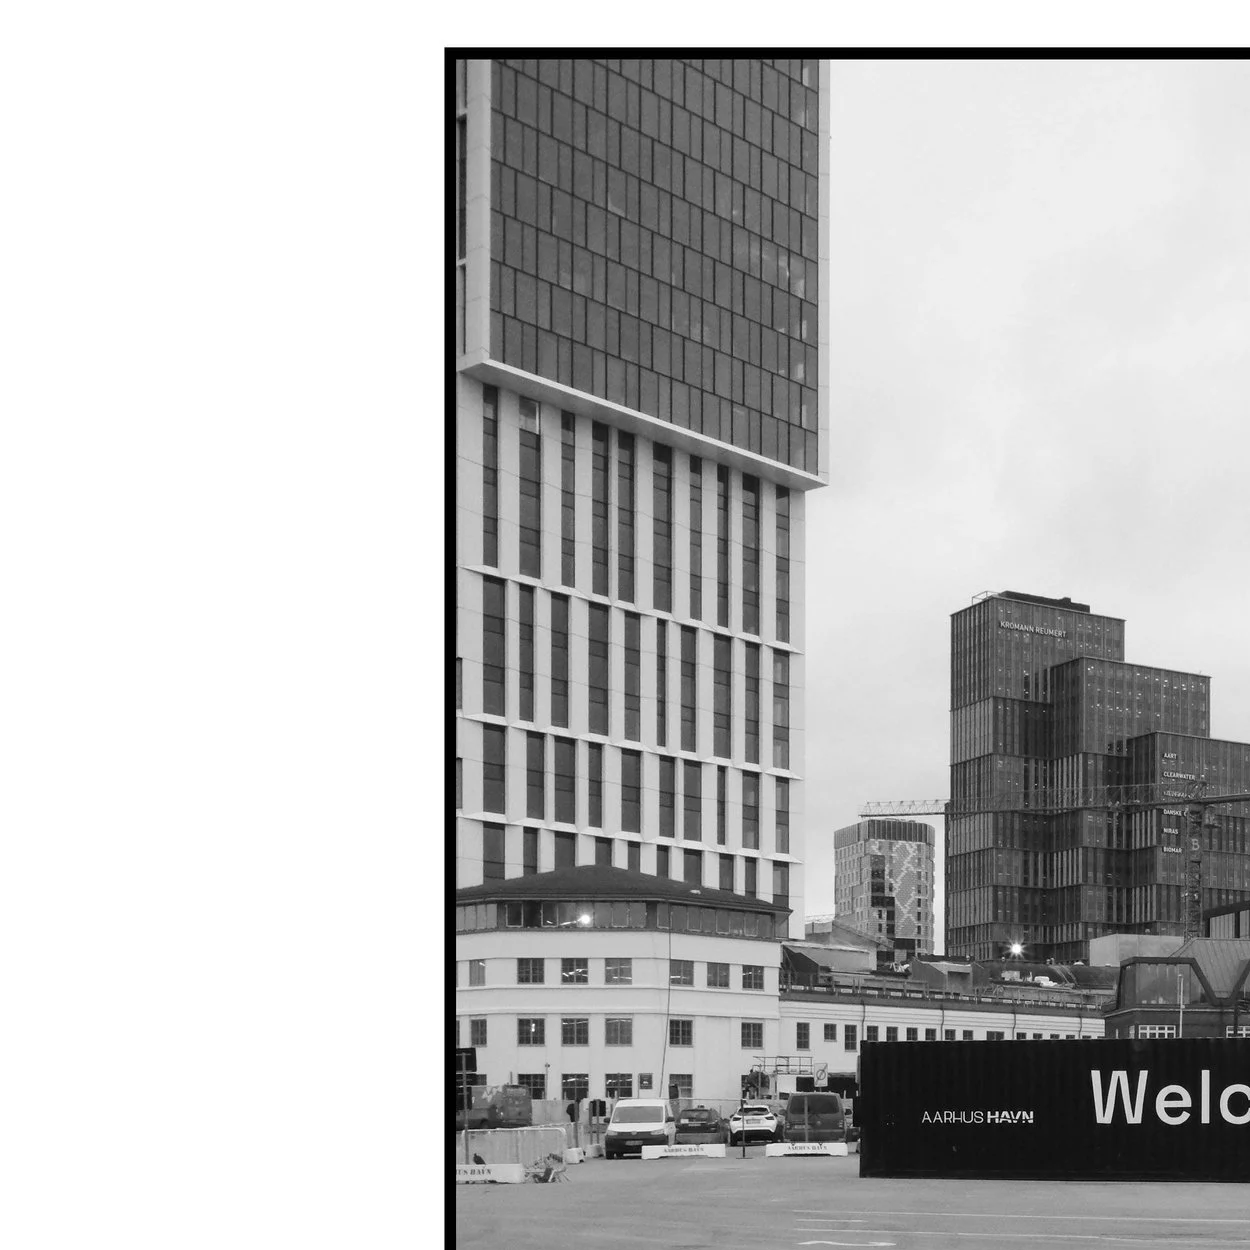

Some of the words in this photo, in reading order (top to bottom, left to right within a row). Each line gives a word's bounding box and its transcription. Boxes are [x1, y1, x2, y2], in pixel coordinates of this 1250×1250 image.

[1000, 621, 1034, 633] KROMANN
[1035, 627, 1067, 638] REUMERT
[1163, 771, 1196, 780] CLEARWATER
[921, 1110, 984, 1124] AARHUS
[986, 1110, 1034, 1124] HAVN
